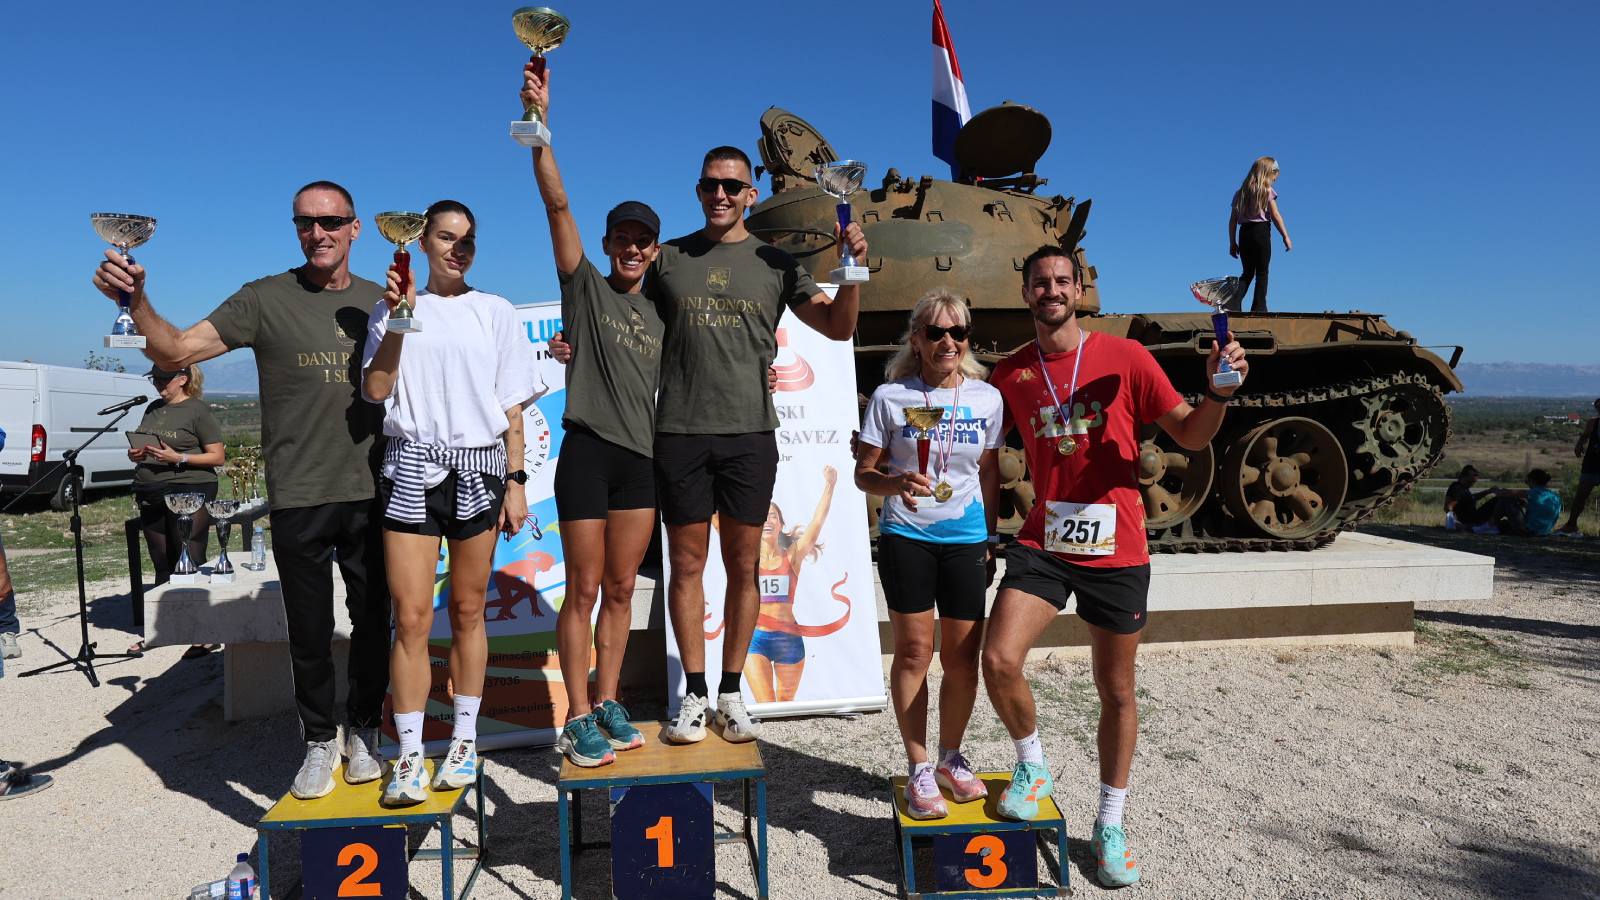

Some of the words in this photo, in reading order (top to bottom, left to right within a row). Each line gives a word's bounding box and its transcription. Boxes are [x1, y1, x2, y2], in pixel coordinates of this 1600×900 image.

[677, 297, 702, 310] ANI
[697, 313, 741, 328] SLAVE
[297, 351, 337, 367] DANI
[324, 369, 330, 383] I
[776, 405, 806, 419] SKI
[779, 430, 839, 444] SAVEZ
[962, 432, 971, 444] it
[1061, 519, 1101, 544] 251
[762, 578, 780, 594] 15
[486, 675, 520, 688] 37036
[646, 816, 674, 868] 1
[964, 834, 1008, 889] 3
[337, 842, 382, 897] 2
